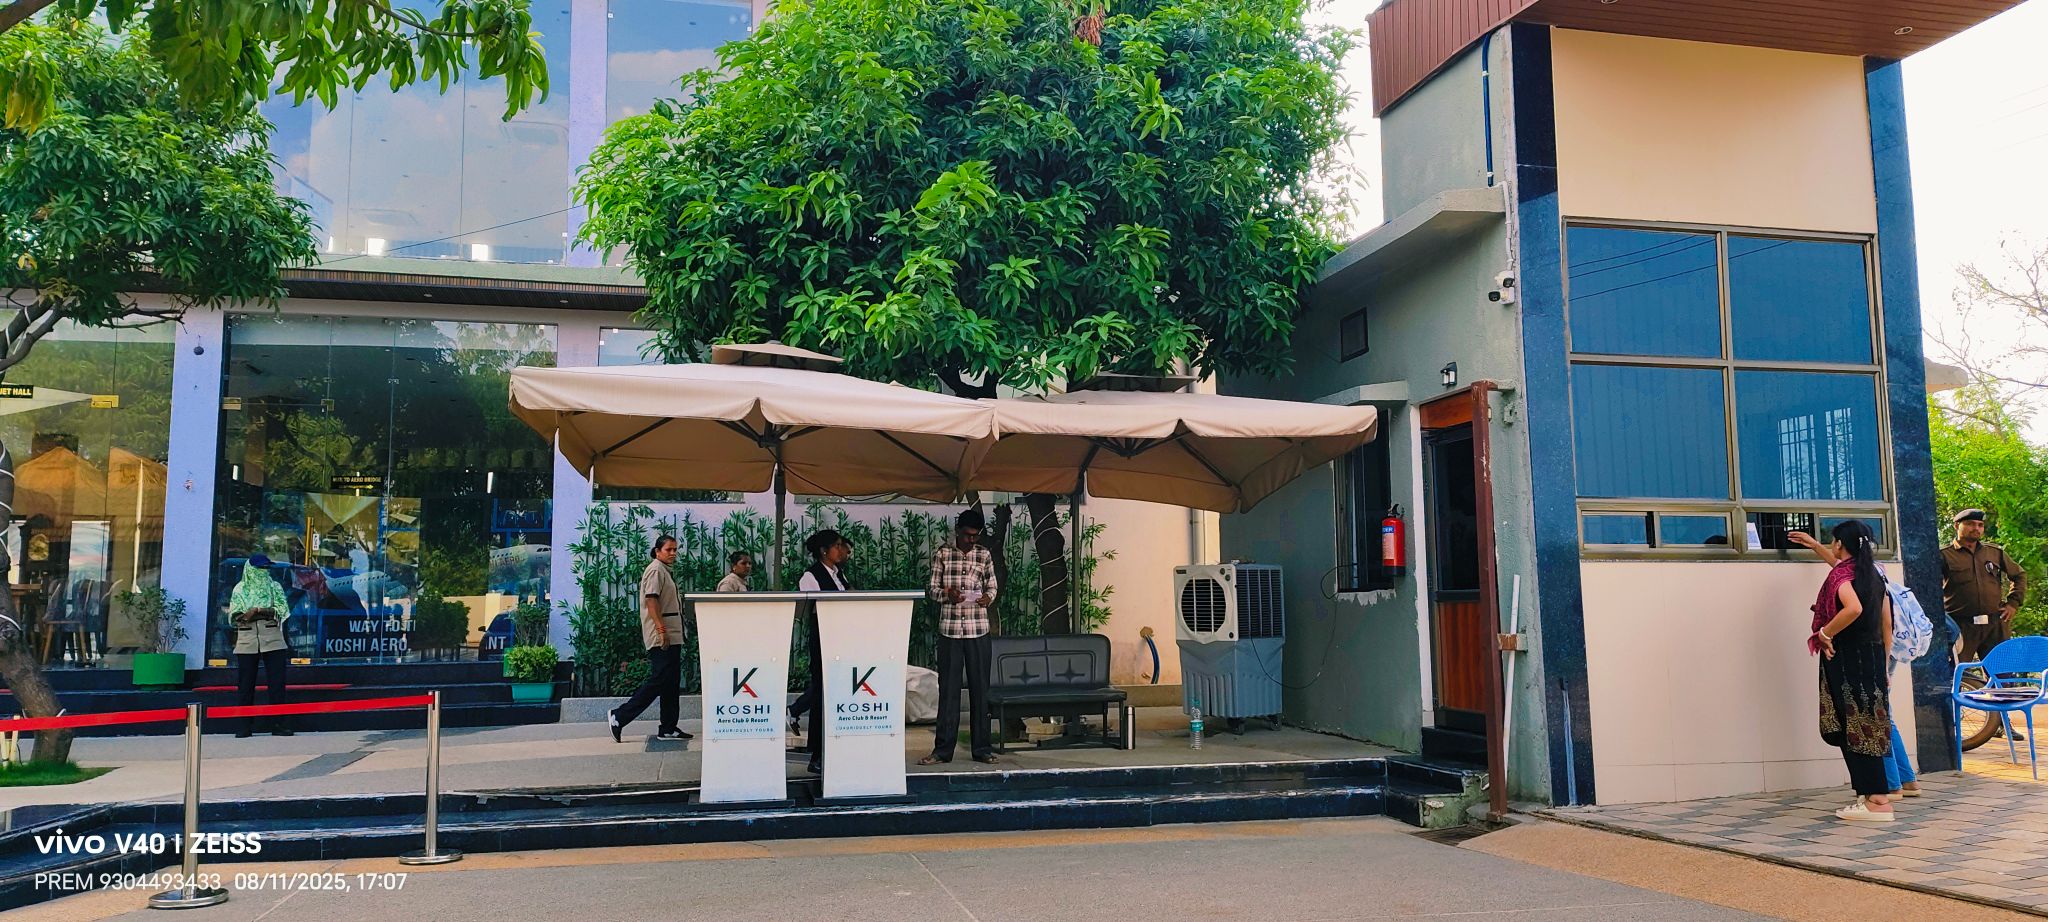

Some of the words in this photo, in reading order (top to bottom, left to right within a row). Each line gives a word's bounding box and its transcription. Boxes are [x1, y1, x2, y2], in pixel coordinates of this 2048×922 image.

[13, 388, 32, 396] HALL
[349, 620, 379, 632] WAY
[383, 619, 400, 632] TO
[325, 638, 366, 652] KOSHI
[370, 637, 407, 652] AERO
[486, 636, 507, 650] NT
[716, 705, 770, 715] KOSHI
[836, 703, 889, 713] KOSHI
